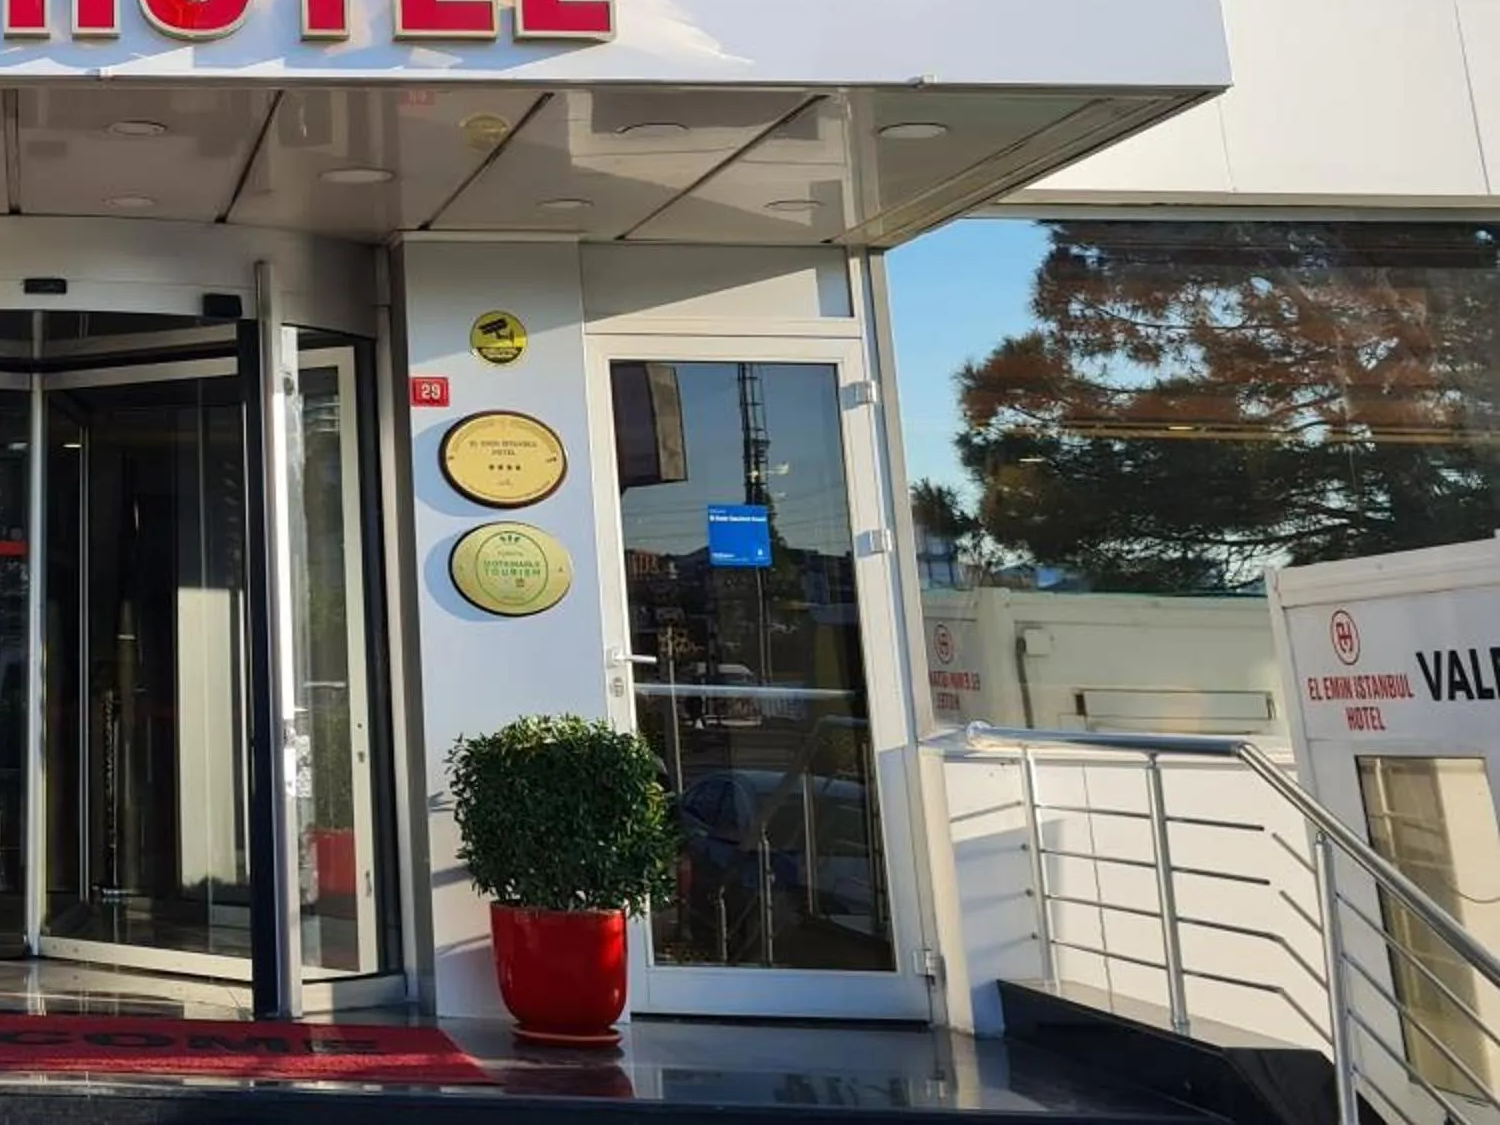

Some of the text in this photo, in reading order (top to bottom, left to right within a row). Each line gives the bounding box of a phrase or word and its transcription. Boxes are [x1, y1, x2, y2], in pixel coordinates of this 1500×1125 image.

[420, 382, 440, 400] 29
[1307, 677, 1323, 700] EL
[1345, 706, 1387, 732] HOTEL
